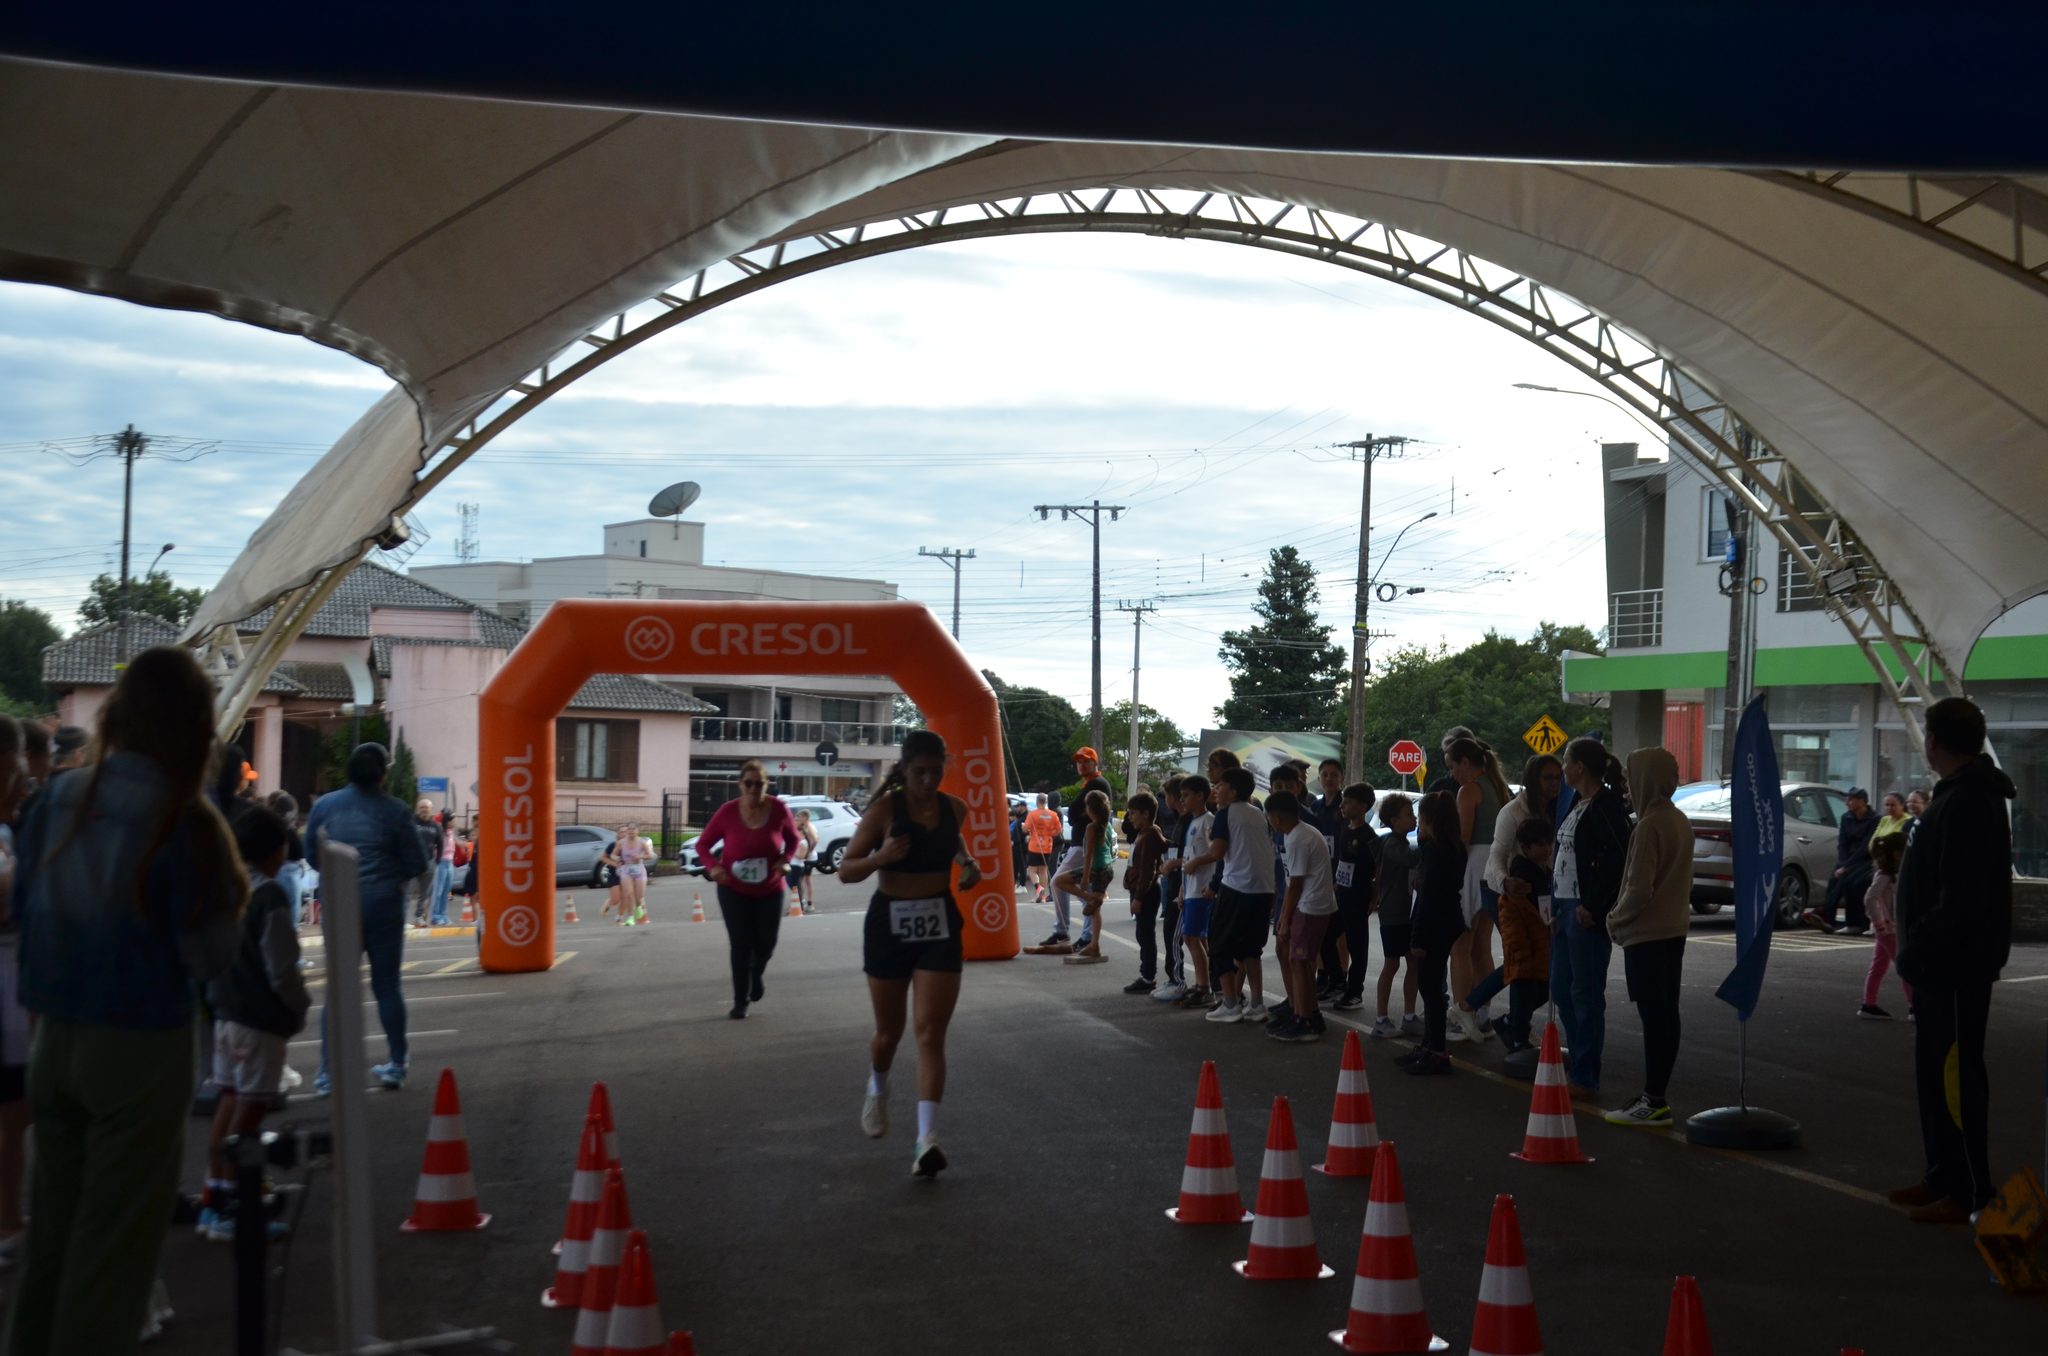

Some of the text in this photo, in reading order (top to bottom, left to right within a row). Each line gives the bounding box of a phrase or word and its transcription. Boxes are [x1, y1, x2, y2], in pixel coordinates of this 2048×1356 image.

[690, 622, 868, 656] CRESOL
[1391, 752, 1420, 763] PARE
[502, 743, 535, 894] CRESOL
[963, 736, 1000, 881] CRESOL
[741, 867, 758, 880] 21
[899, 914, 941, 939] 582
